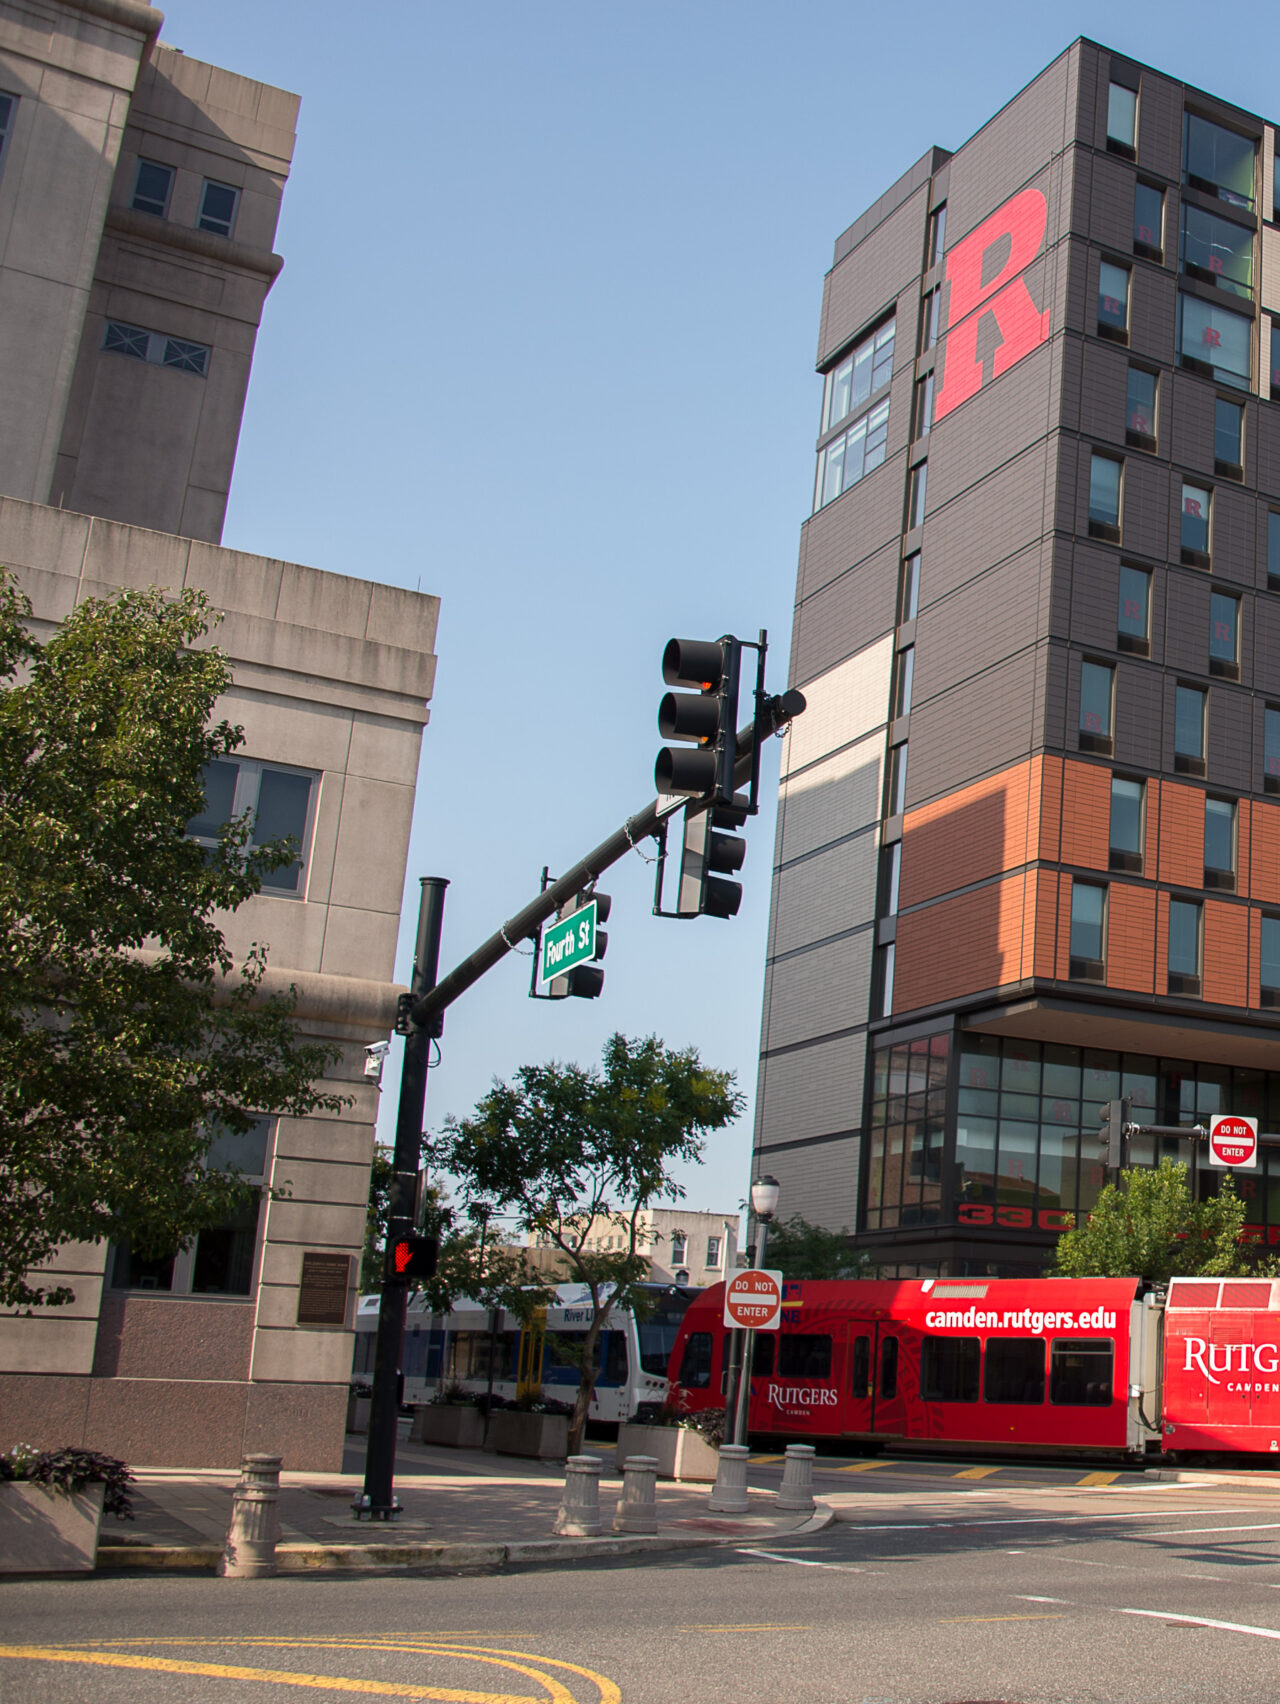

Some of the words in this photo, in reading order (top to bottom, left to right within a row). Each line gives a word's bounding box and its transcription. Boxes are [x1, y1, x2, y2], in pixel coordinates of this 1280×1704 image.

[934, 187, 1051, 424] R
[546, 930, 575, 968] Fourth
[578, 920, 590, 949] St
[1221, 1125, 1231, 1134] DO
[1233, 1126, 1247, 1135] NOT
[1222, 1147, 1244, 1157] ENTER
[735, 1281, 749, 1290] DO
[754, 1282, 773, 1292] NOT
[564, 1309, 584, 1322] River
[737, 1306, 768, 1317] ENTER
[925, 1306, 1117, 1334] camden.rutgers.edu
[1227, 1382, 1280, 1393] CAMDEN
[768, 1383, 838, 1411] RUTGERS
